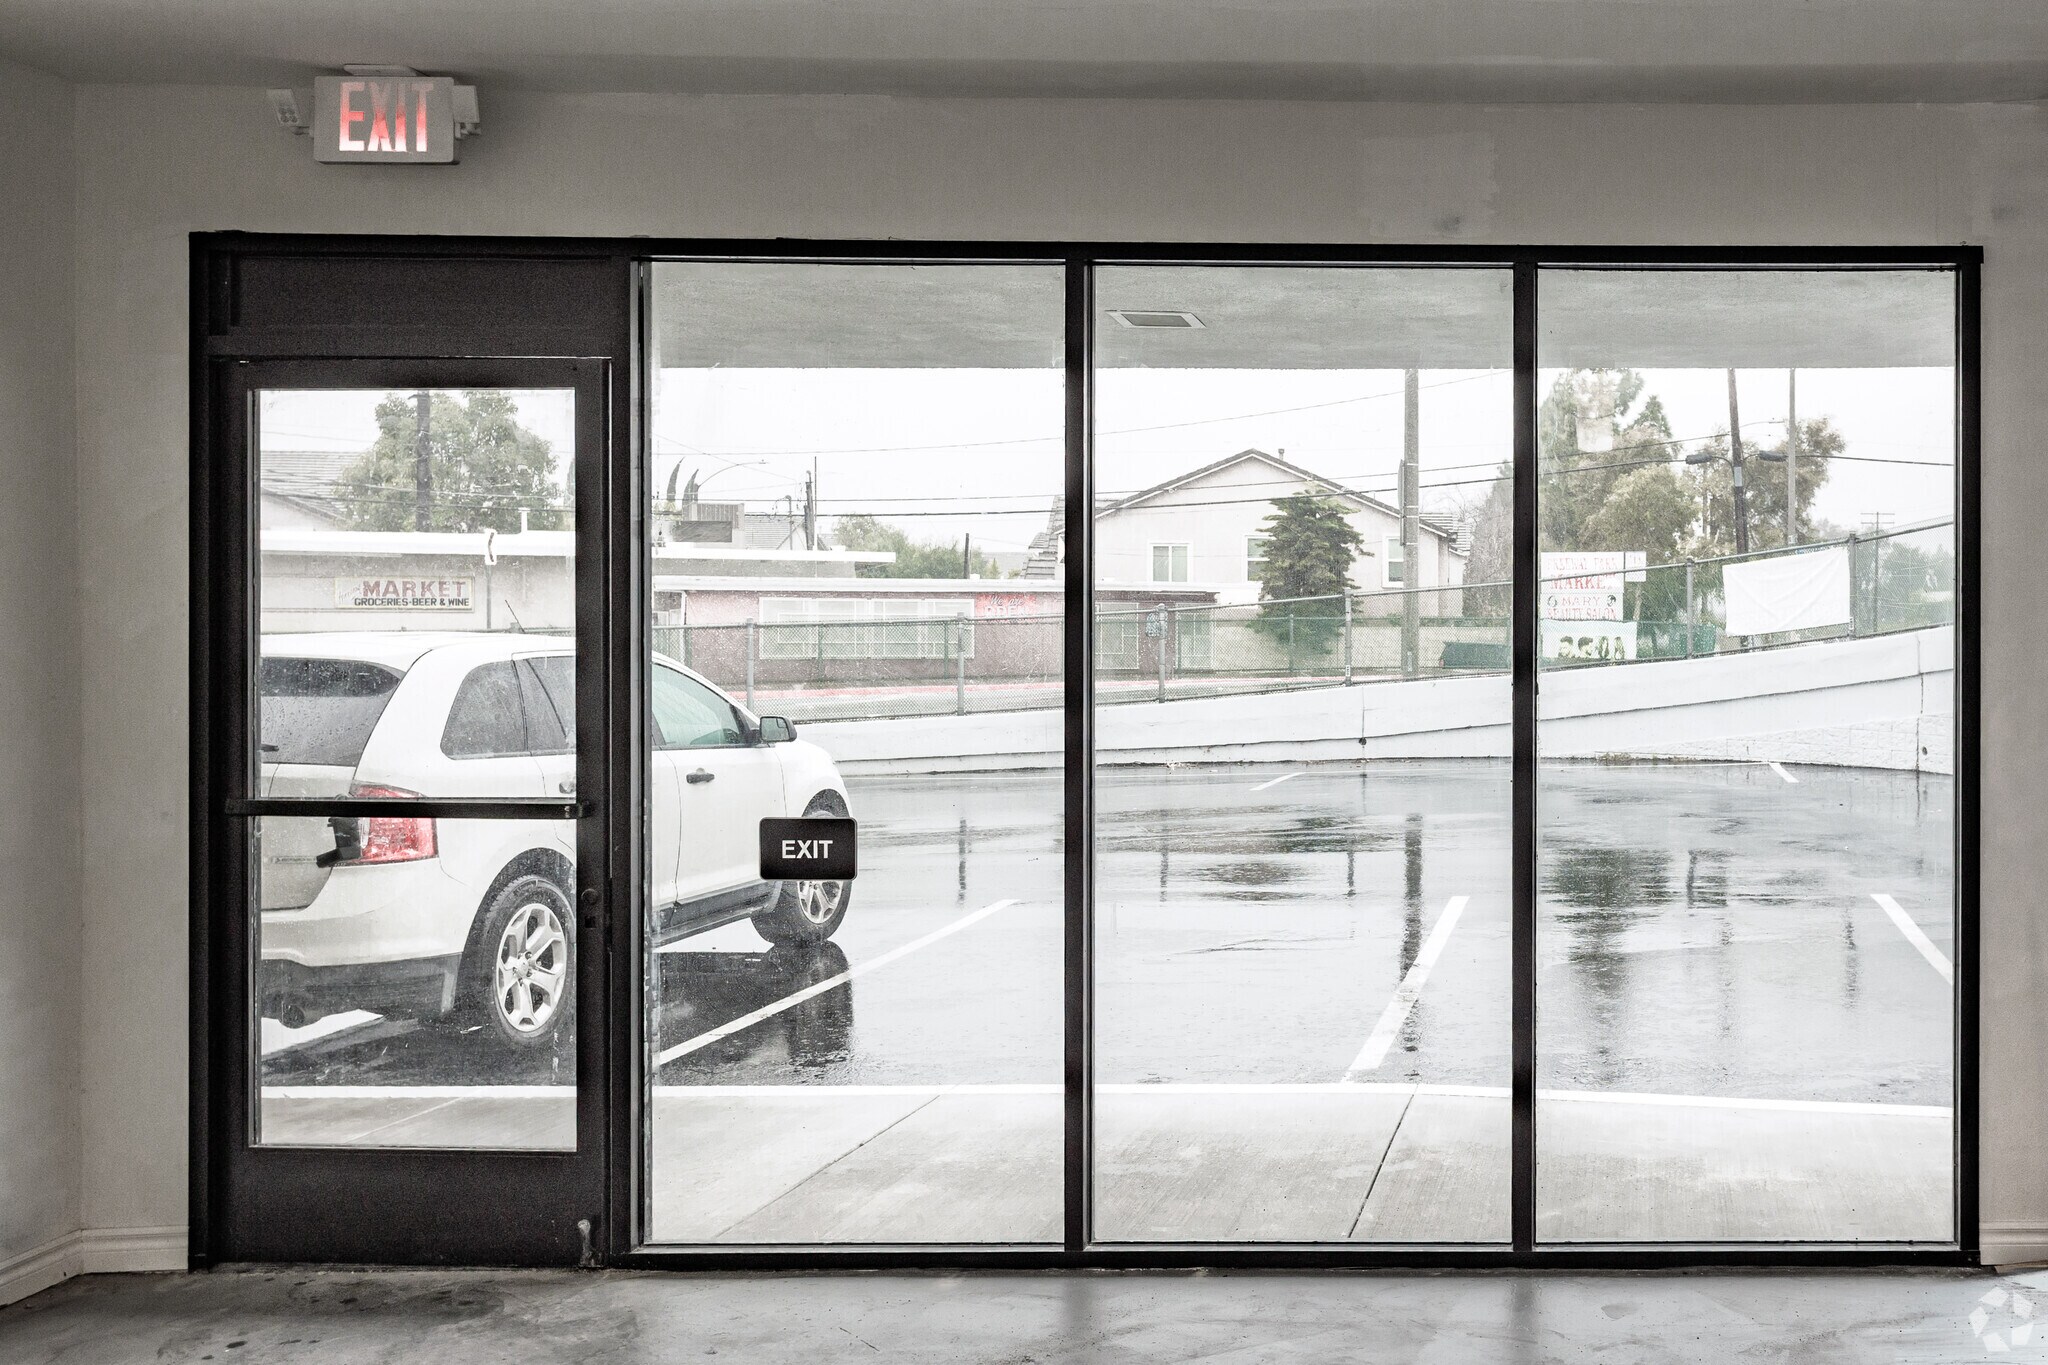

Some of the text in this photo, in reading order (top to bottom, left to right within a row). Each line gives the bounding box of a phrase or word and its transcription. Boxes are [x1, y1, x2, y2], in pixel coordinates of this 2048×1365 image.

[339, 81, 434, 152] EXIT
[362, 580, 466, 598] MARKET
[439, 597, 446, 607] &
[449, 597, 470, 607] WINE
[1561, 596, 1601, 606] MARY
[781, 839, 834, 859] EXIT
